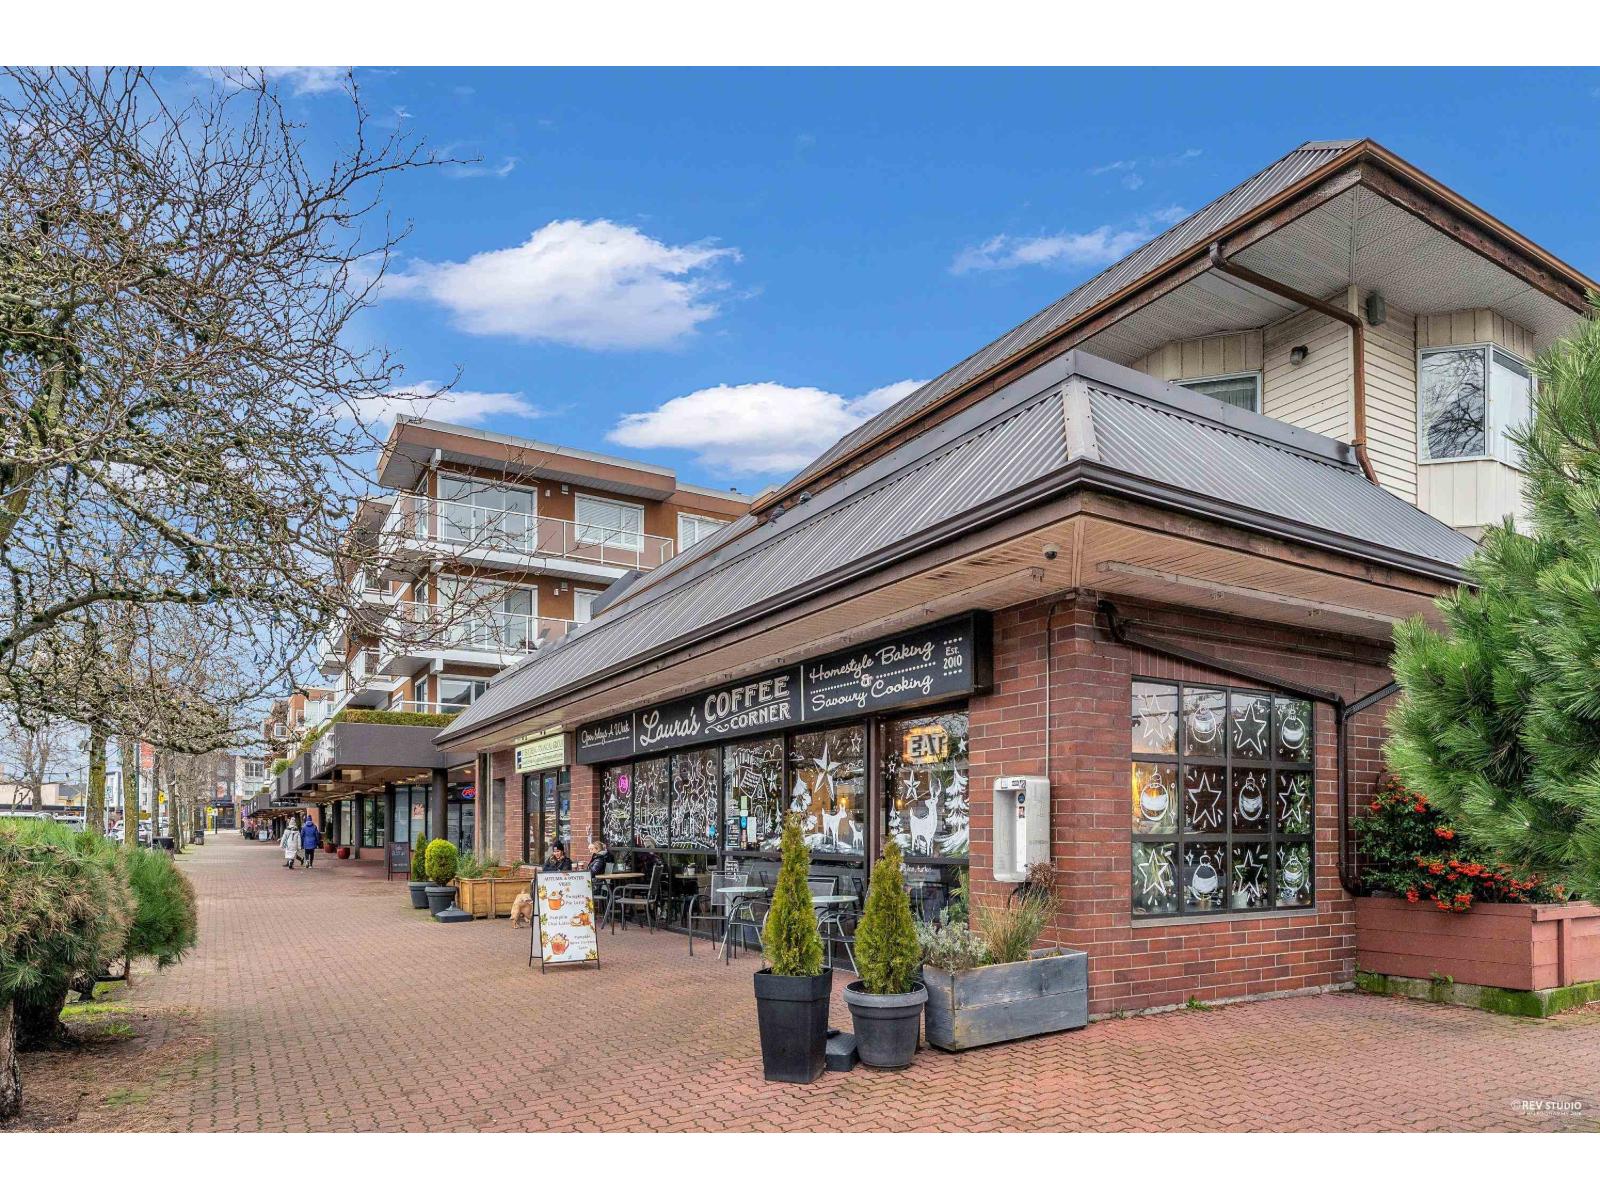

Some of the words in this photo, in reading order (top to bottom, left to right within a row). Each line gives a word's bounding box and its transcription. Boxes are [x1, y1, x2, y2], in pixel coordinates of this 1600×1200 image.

[809, 654, 874, 684] Homestyle
[875, 641, 935, 666] Baking
[943, 655, 963, 670] 2010
[811, 691, 868, 712] Savoury
[871, 675, 934, 698] Cooking
[860, 673, 874, 687] &
[703, 675, 791, 724] COFFEE
[639, 706, 701, 747] Laura's
[730, 702, 792, 730] CORNER
[908, 733, 947, 758] EAT
